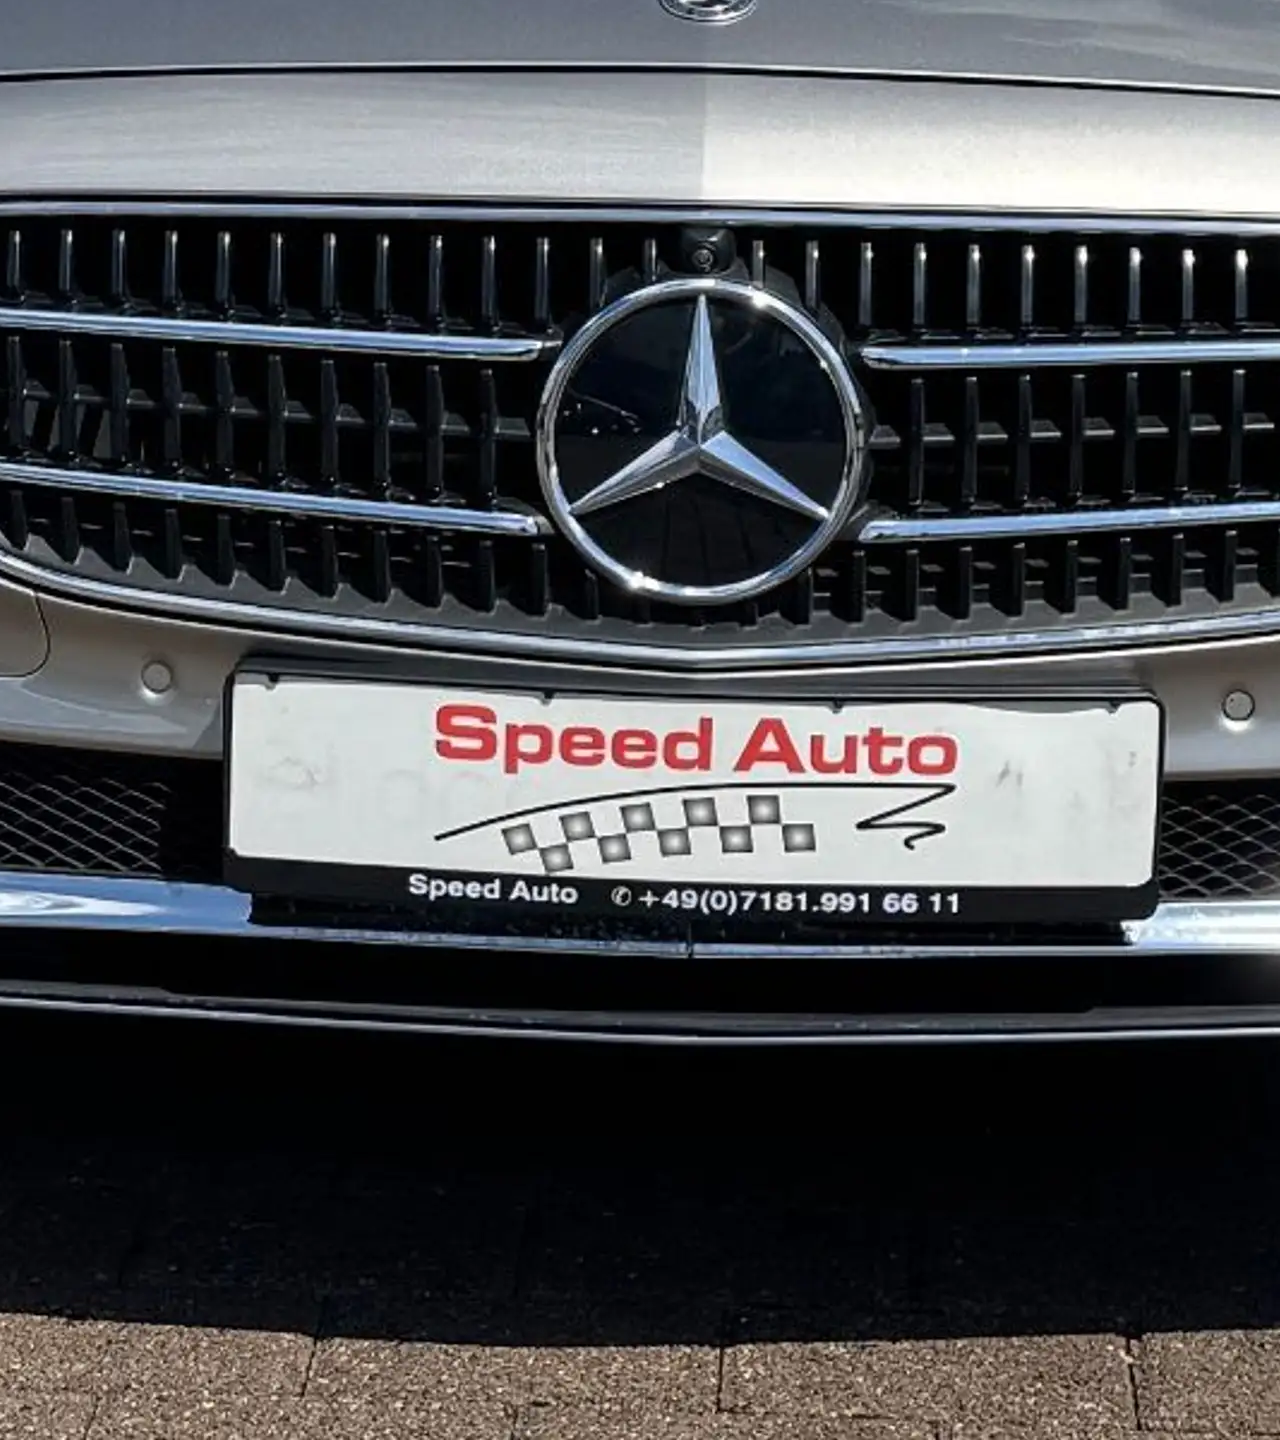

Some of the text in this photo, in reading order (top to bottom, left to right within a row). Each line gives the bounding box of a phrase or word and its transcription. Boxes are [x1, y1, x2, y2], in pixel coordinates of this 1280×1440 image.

[434, 704, 959, 777] Speed Auto
[408, 873, 961, 916] Speed Auto +49(0)7181.991 66 11
